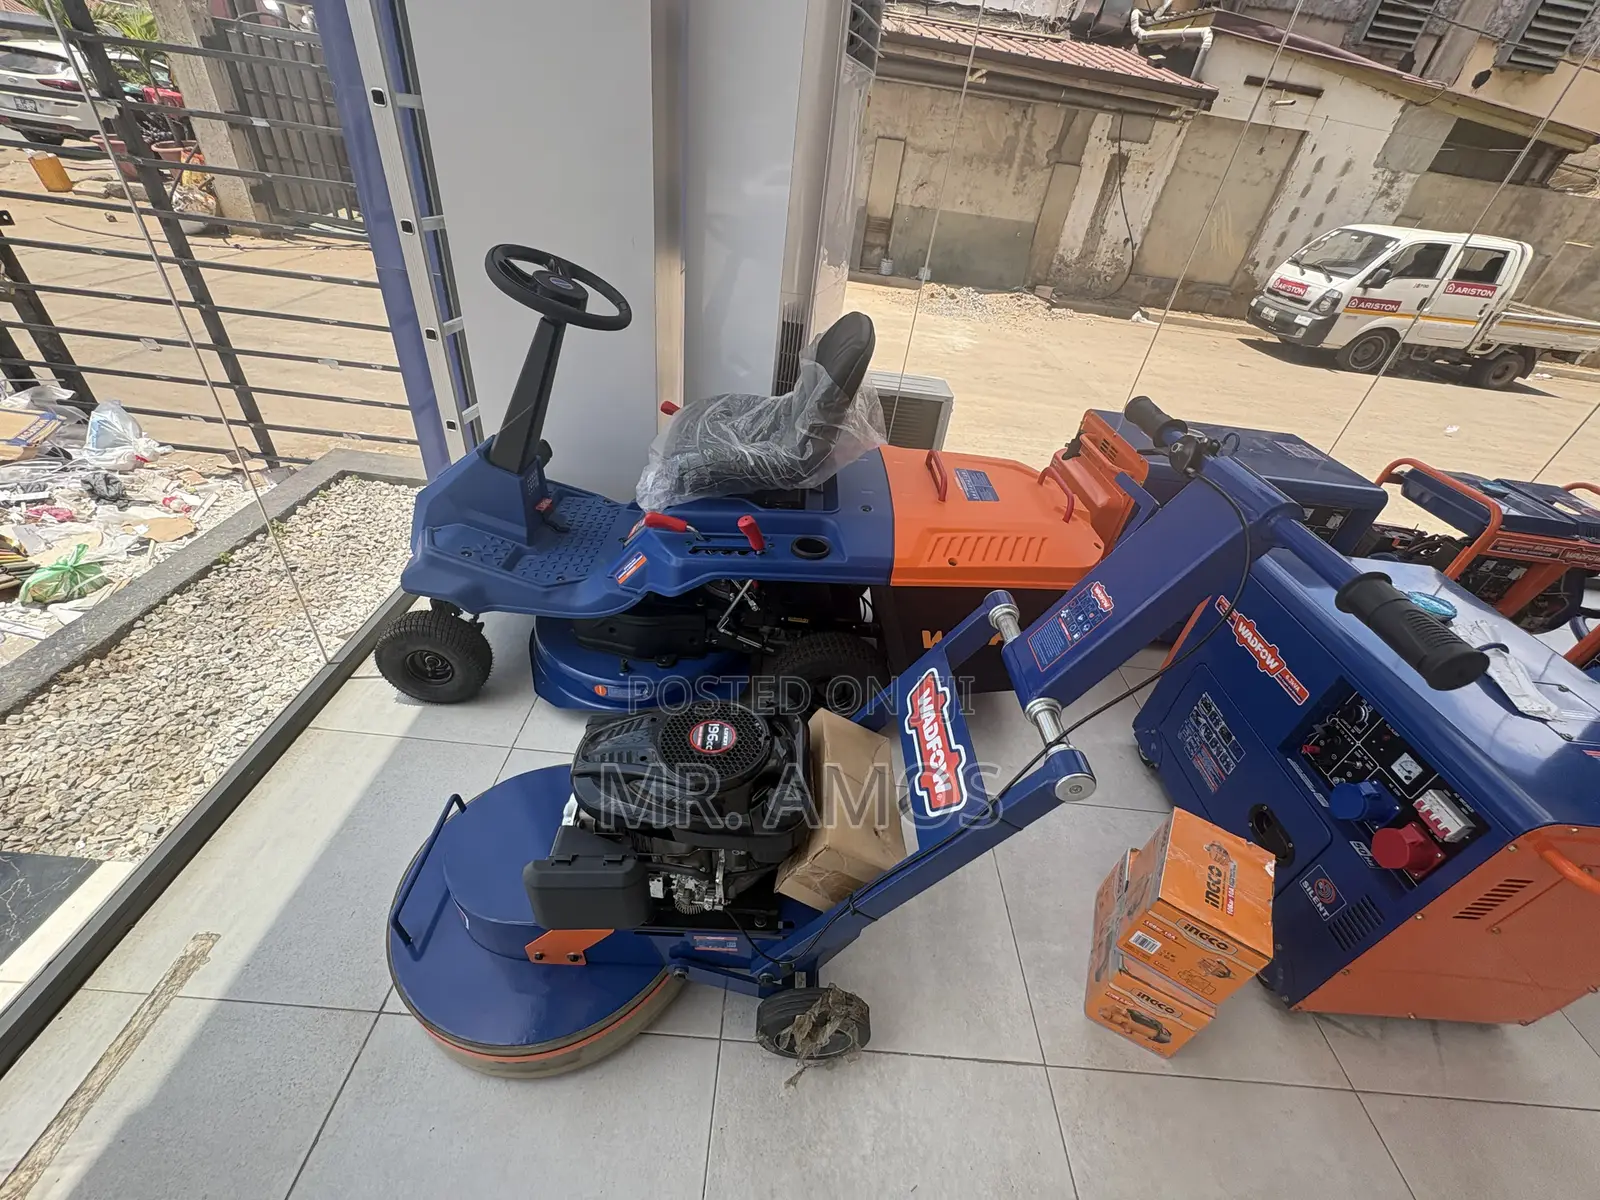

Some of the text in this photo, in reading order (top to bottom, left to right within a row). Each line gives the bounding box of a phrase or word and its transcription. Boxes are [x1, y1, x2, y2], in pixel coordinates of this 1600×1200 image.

[1279, 282, 1306, 295] ARISTON
[1454, 286, 1494, 297] ARISTON
[1358, 302, 1399, 312] ARISTON
[1238, 621, 1279, 669] WADFOW
[705, 723, 720, 750] 196cc
[917, 687, 953, 795] WADFOW
[1302, 880, 1330, 917] SILENT
